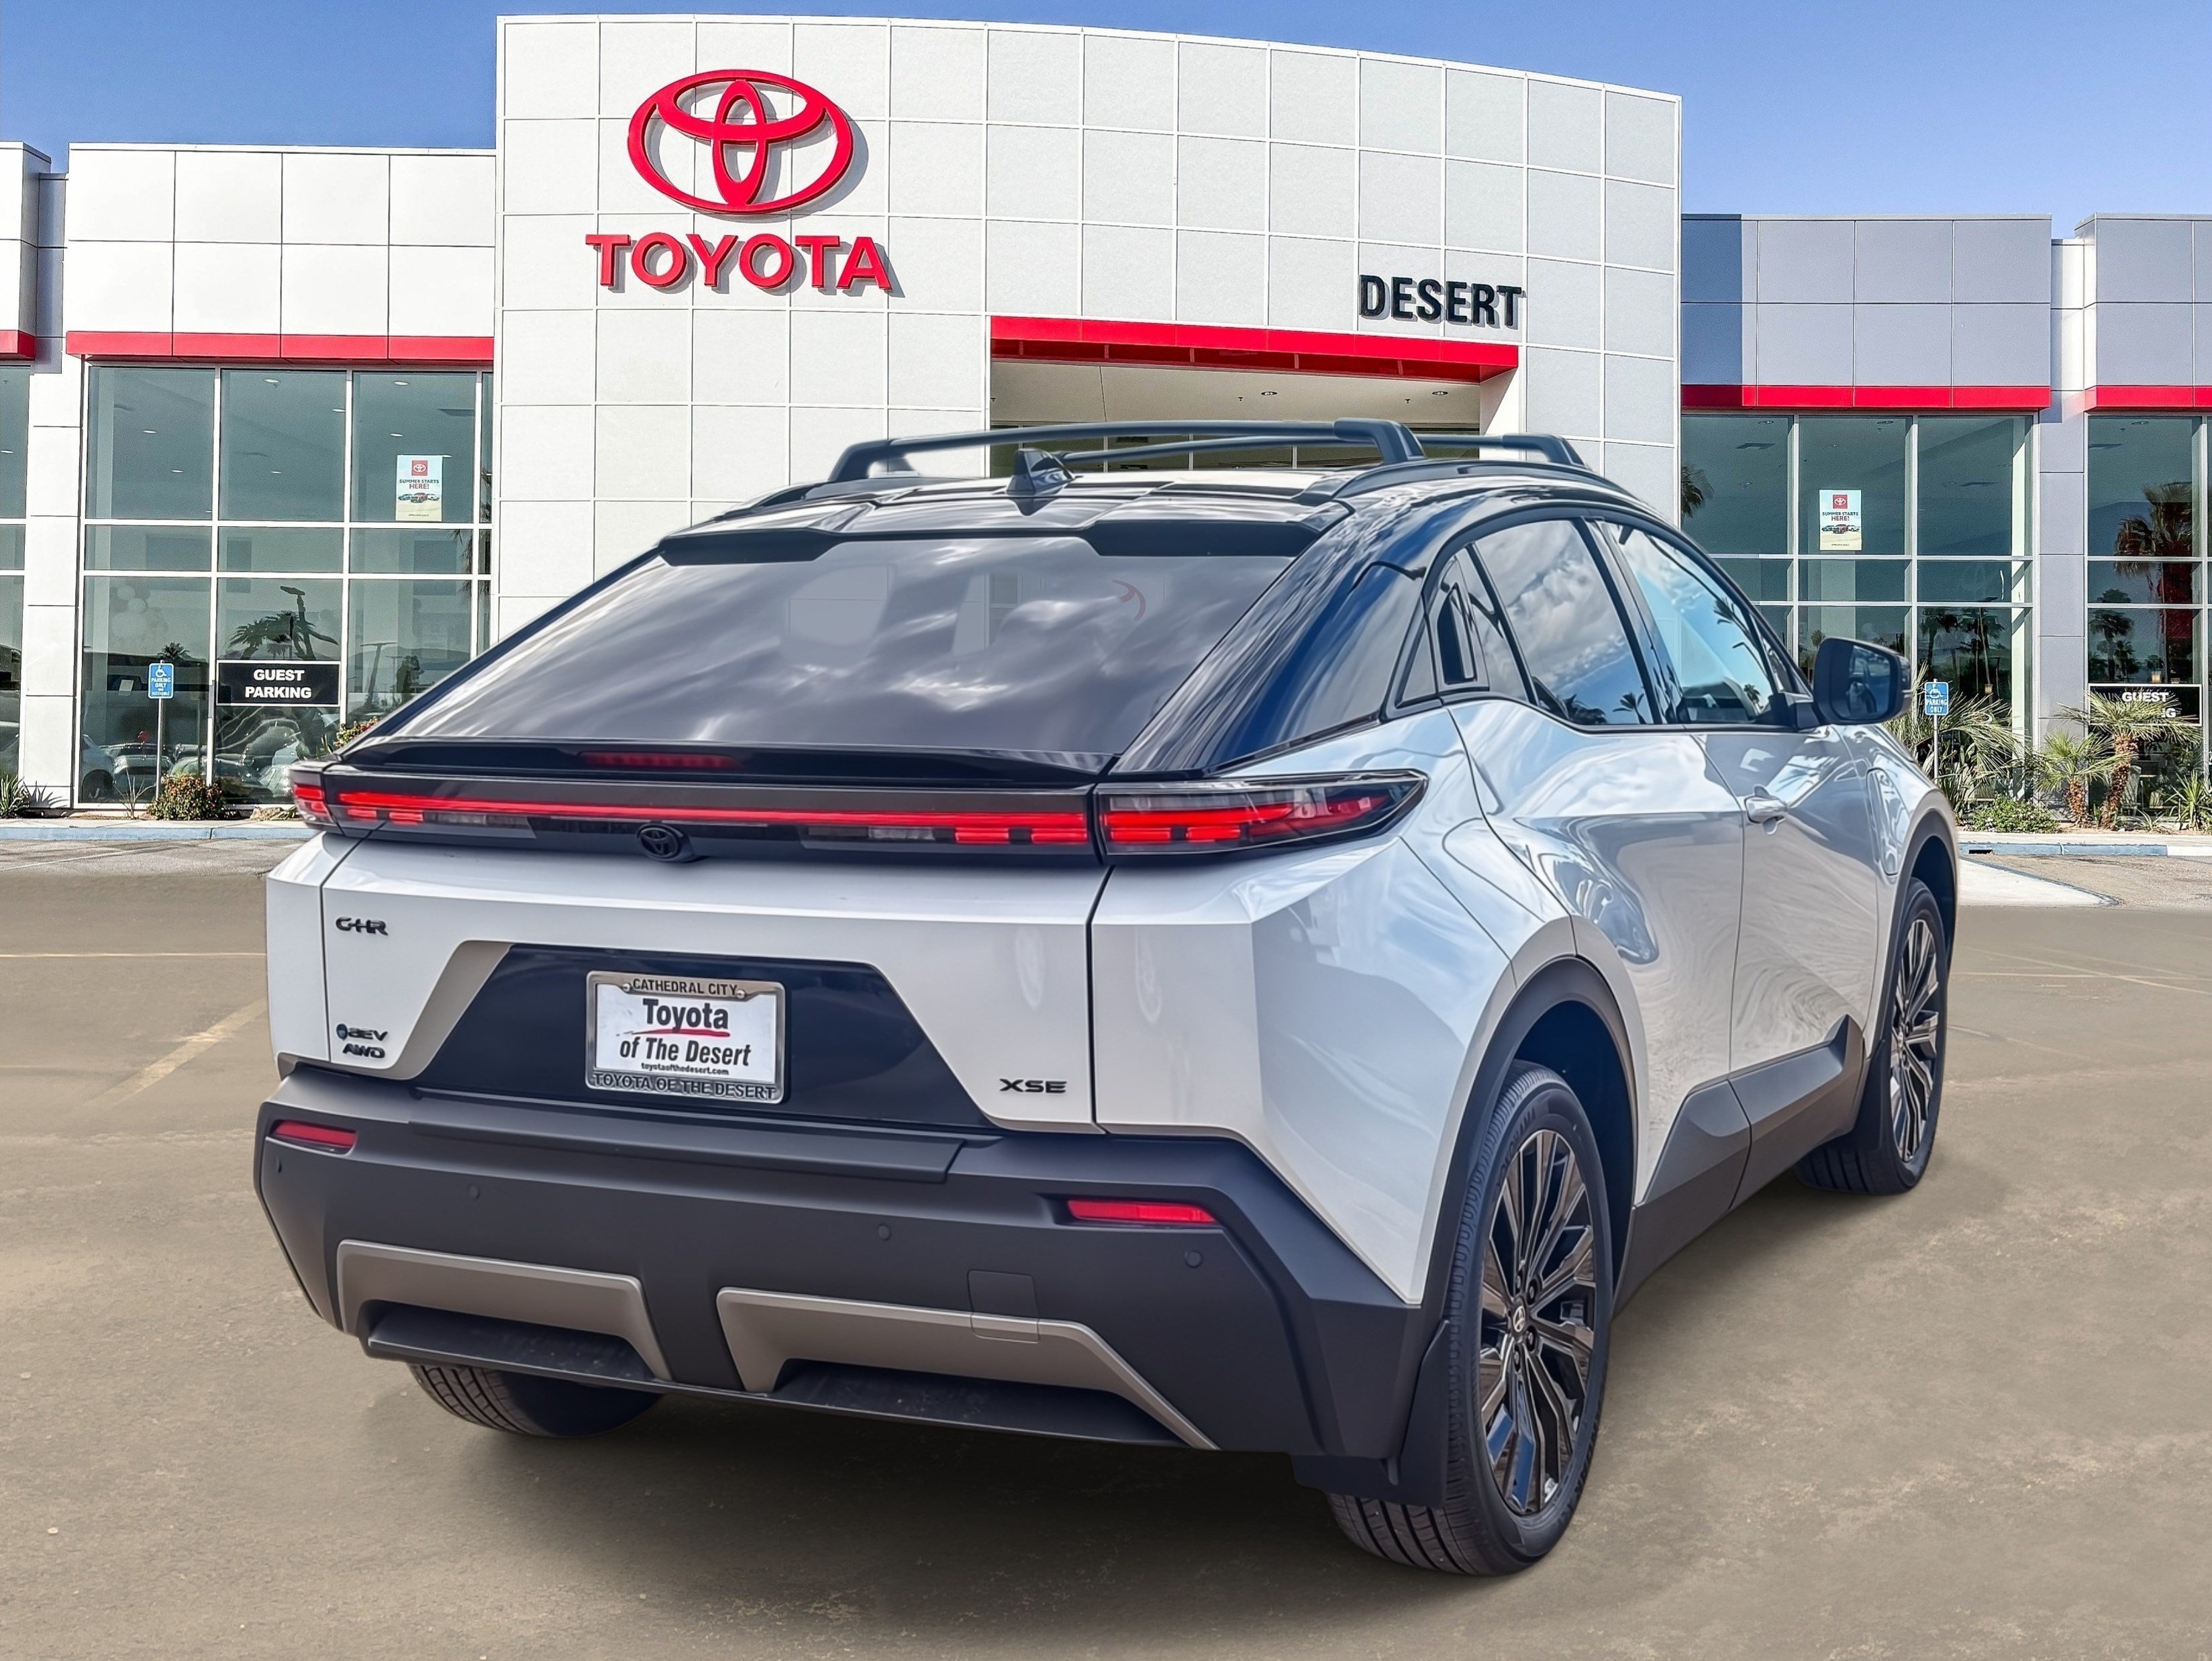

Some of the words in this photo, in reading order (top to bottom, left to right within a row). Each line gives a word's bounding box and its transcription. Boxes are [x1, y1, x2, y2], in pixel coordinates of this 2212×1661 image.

[585, 232, 893, 291] TOYOTA
[1359, 274, 1522, 327] DESERT
[253, 669, 305, 681] GUEST
[245, 686, 312, 699] PARKING
[2121, 692, 2170, 702] GUEST
[632, 978, 705, 995] CATHEDRAL
[708, 983, 738, 996] CITY
[642, 998, 729, 1032] Toyota
[342, 1043, 385, 1058] AWD
[619, 1037, 640, 1058] of
[646, 1038, 679, 1062] The
[685, 1040, 752, 1066] Desert
[641, 1062, 730, 1075] toyotaofthedesert.com
[593, 1074, 651, 1090] TOYOTA
[656, 1078, 676, 1091] OF
[681, 1080, 711, 1095] THE
[715, 1083, 776, 1100] DESERT
[999, 1078, 1068, 1094] XSE
